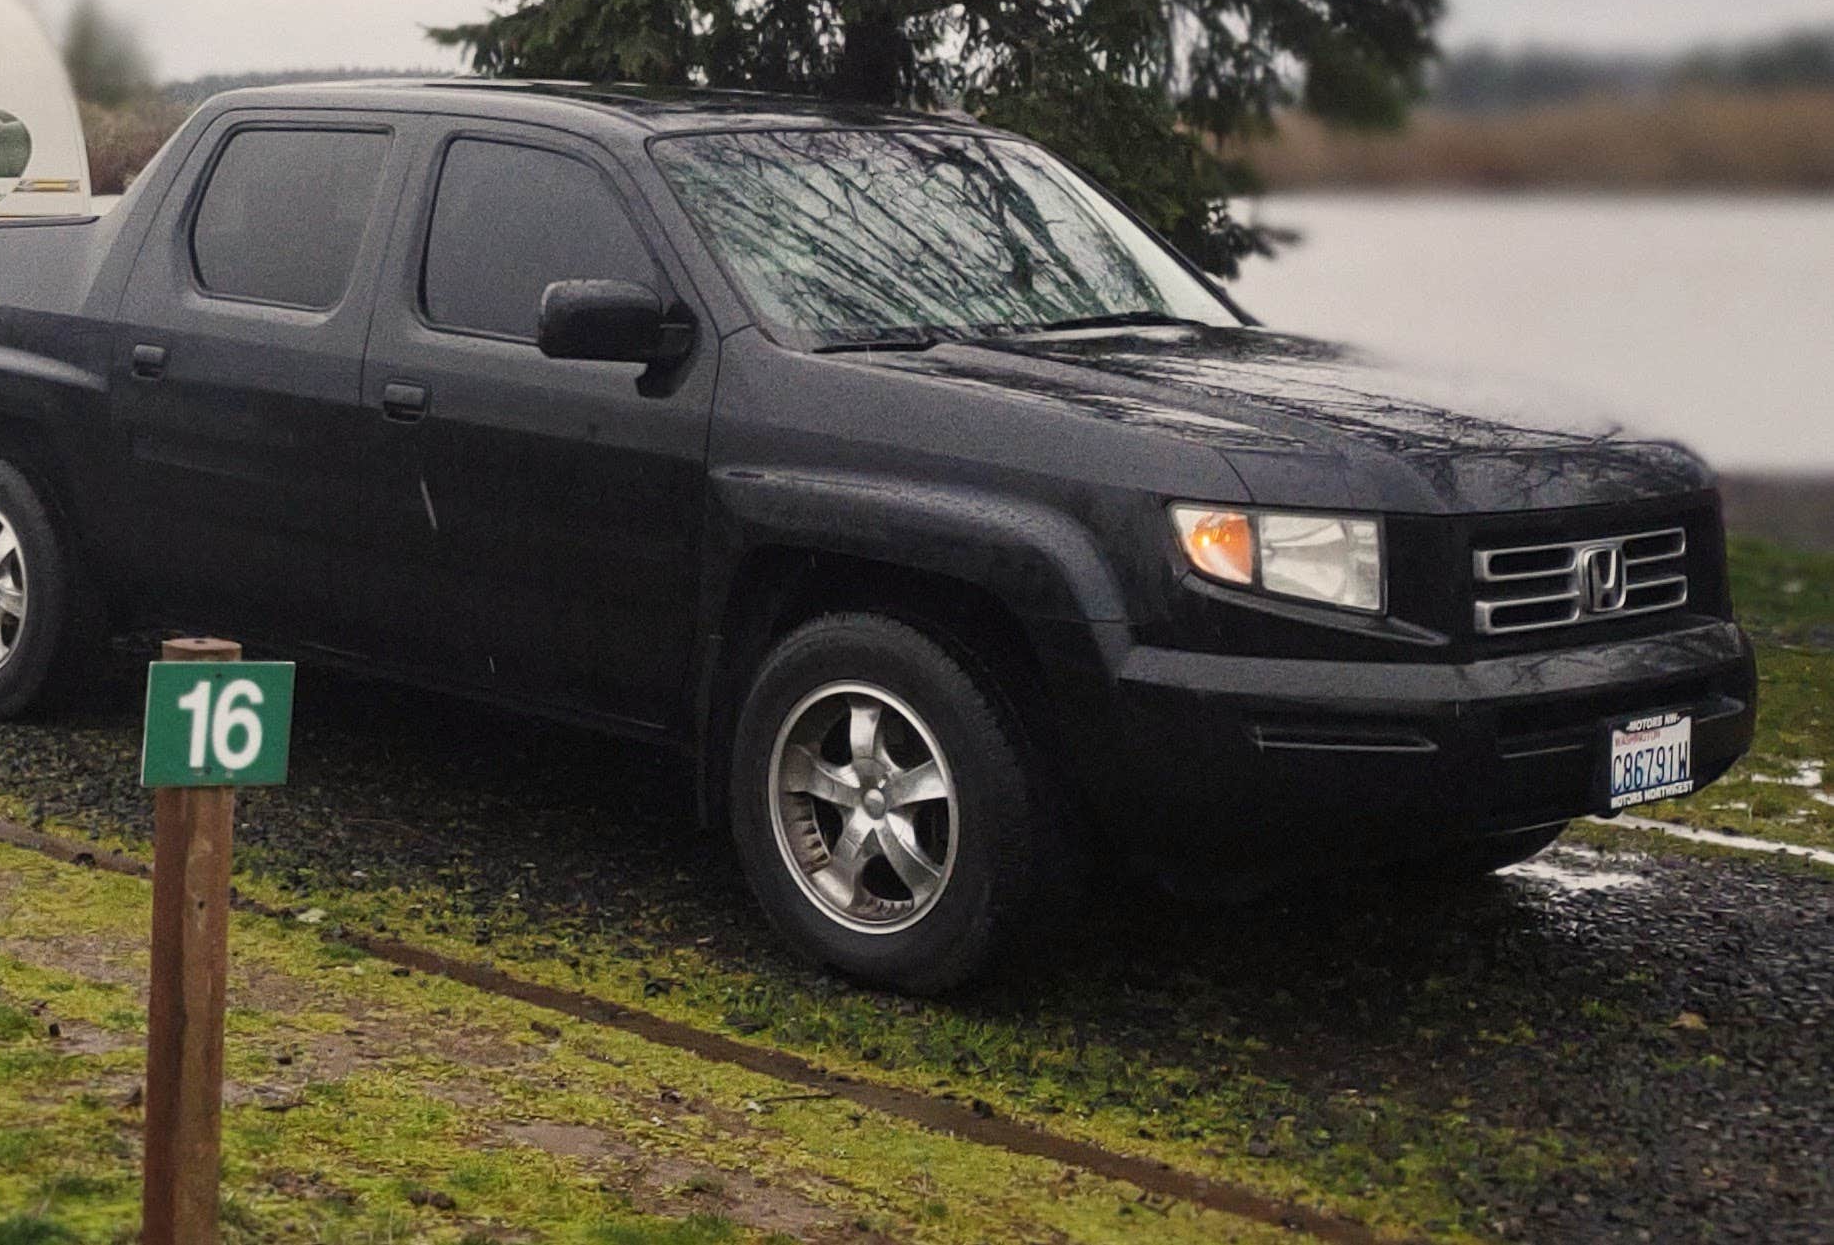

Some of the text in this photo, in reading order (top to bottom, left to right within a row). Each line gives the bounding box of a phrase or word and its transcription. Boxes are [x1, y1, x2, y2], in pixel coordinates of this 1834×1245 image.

[178, 679, 264, 770] 16
[1612, 741, 1688, 793] C86791W
[1611, 792, 1643, 809] MOTORS
